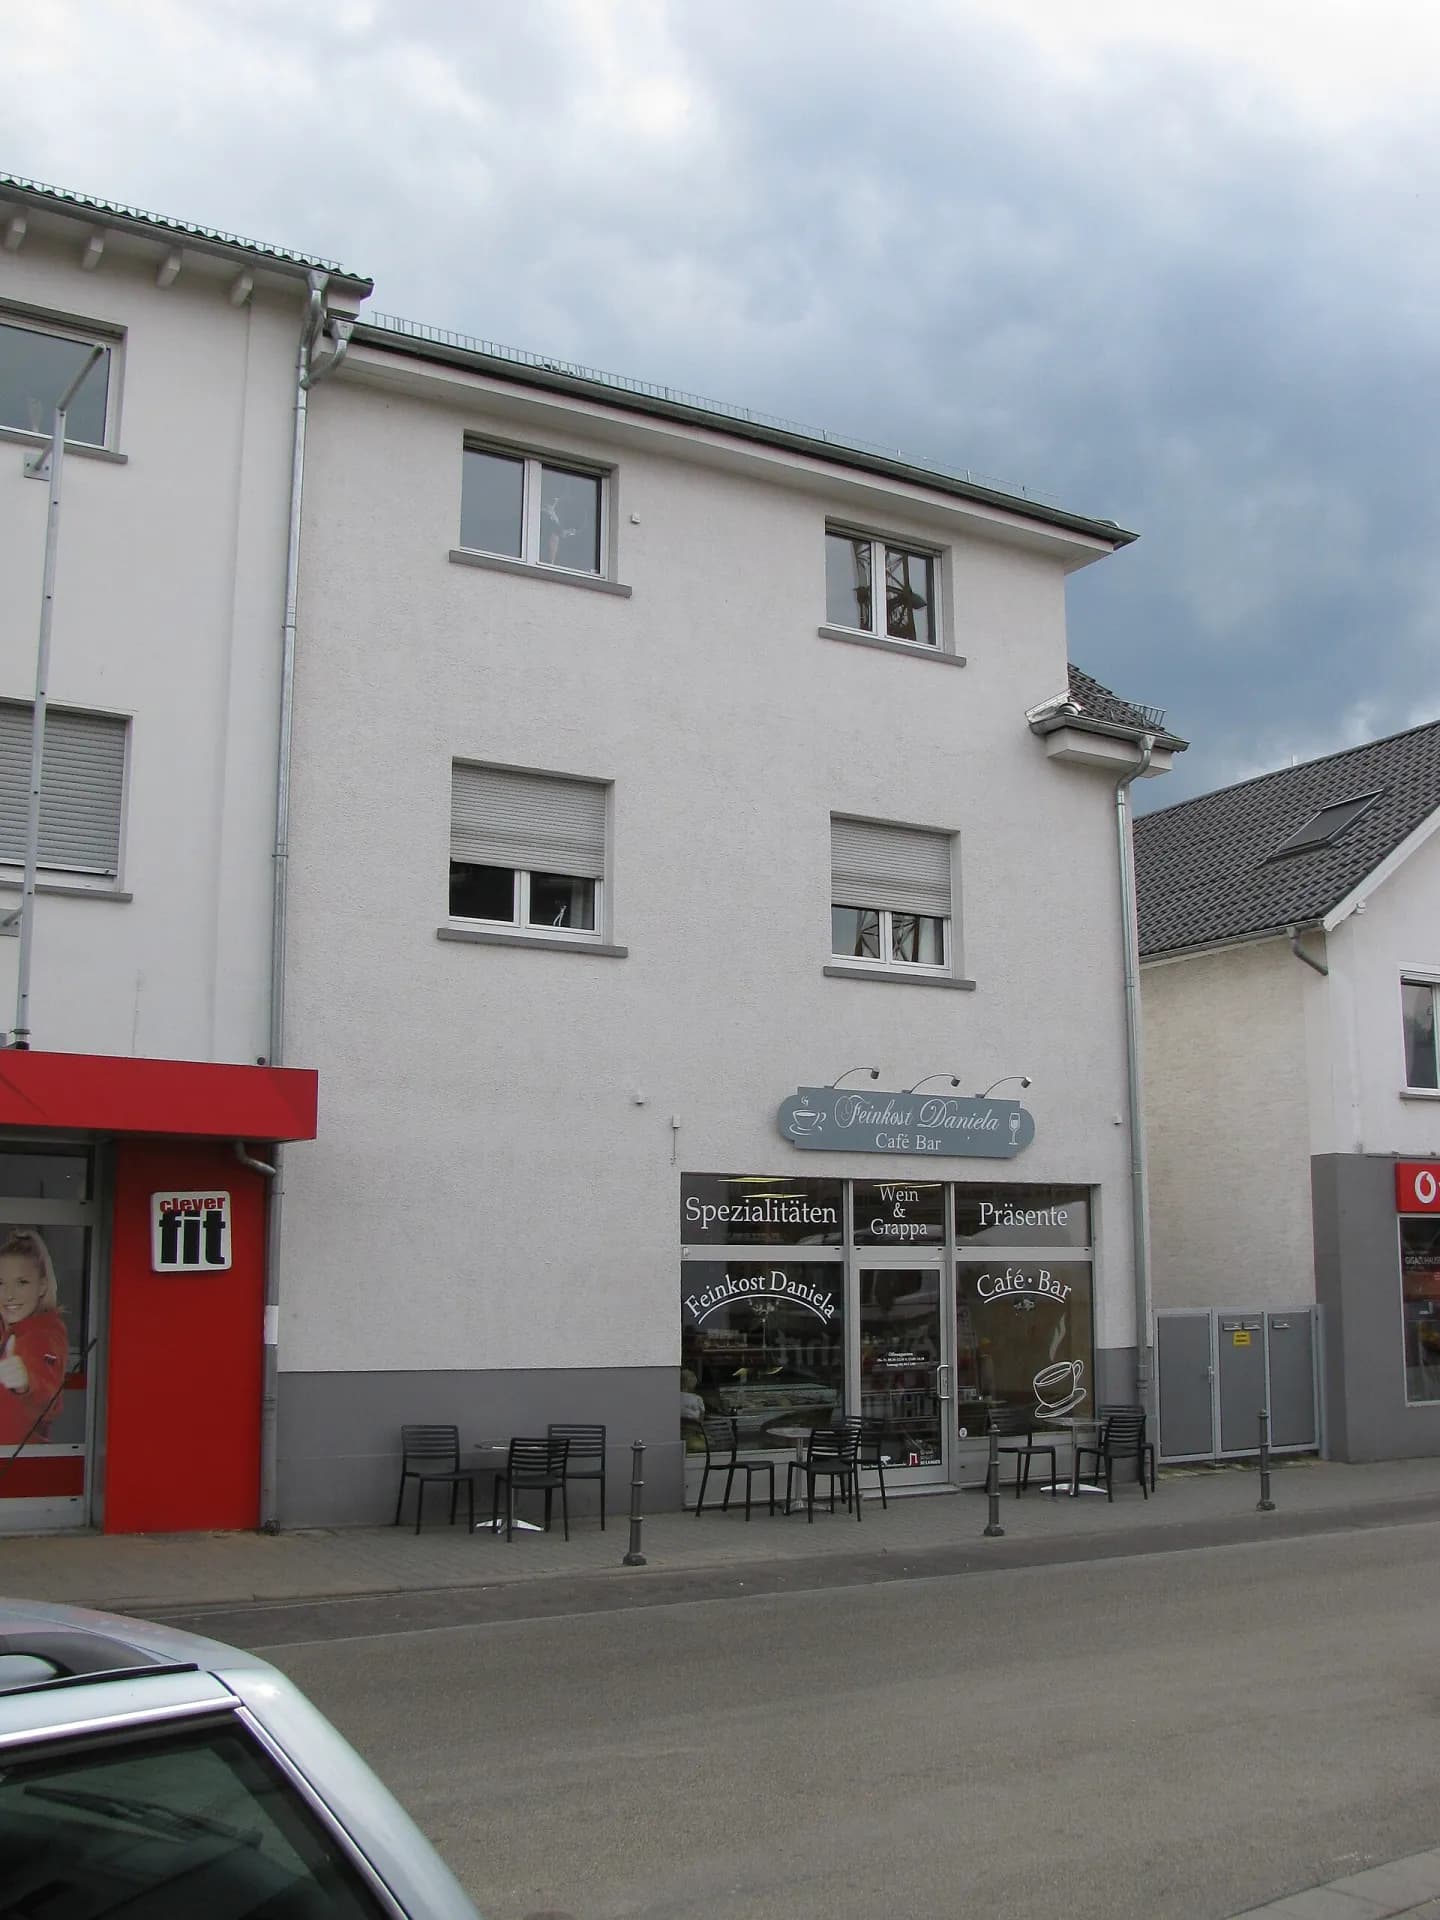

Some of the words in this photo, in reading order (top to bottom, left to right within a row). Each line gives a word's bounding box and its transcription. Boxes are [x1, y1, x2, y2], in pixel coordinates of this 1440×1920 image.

[834, 1094, 912, 1128] Feinkost
[916, 1098, 1000, 1131] Daniela
[875, 1132, 909, 1150] Café
[915, 1134, 941, 1150] Bar
[159, 1196, 226, 1213] clever
[880, 1186, 920, 1202] Wein
[685, 1196, 838, 1230] Spezialitäten
[892, 1202, 906, 1219] &
[978, 1202, 1068, 1226] Präsente
[158, 1211, 226, 1265] fit
[870, 1219, 929, 1241] Grappa
[684, 1273, 766, 1318] Feinkost
[770, 1270, 836, 1319] Daniela
[976, 1267, 1025, 1297] Café
[1037, 1268, 1072, 1300] Bar
